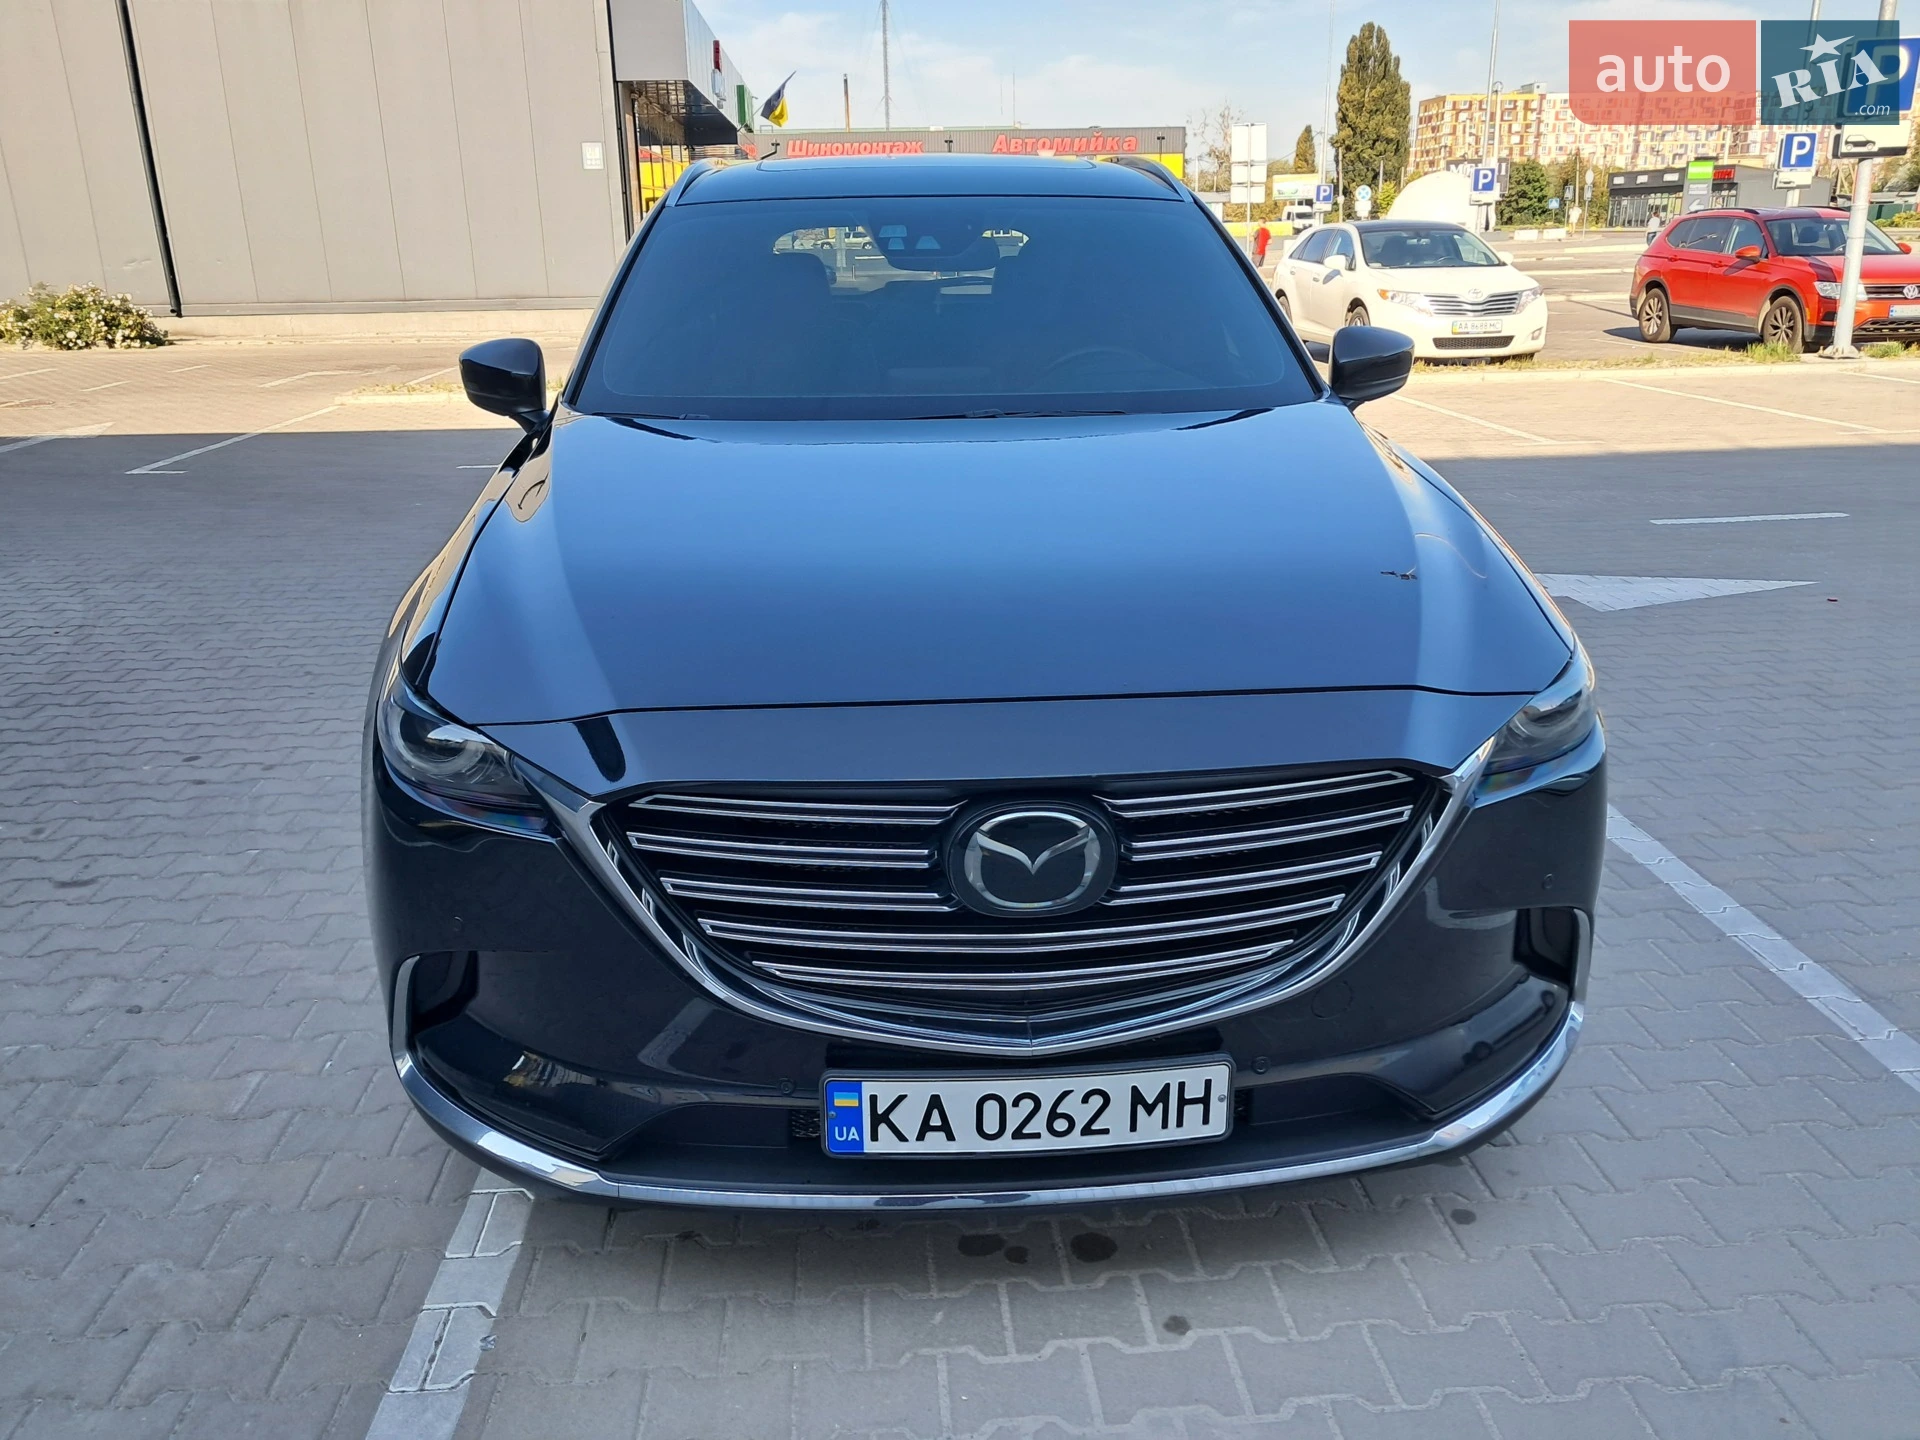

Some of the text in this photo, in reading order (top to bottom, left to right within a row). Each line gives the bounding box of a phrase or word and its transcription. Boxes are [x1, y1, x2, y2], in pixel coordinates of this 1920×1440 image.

[785, 139, 925, 158] Шиномонтаж
[992, 131, 1138, 154] Автомийка
[1790, 135, 1811, 165] P
[1478, 169, 1493, 190] P
[1320, 185, 1331, 201] P
[868, 1078, 1213, 1142] KA 0262 MH
[834, 1125, 860, 1142] UA
